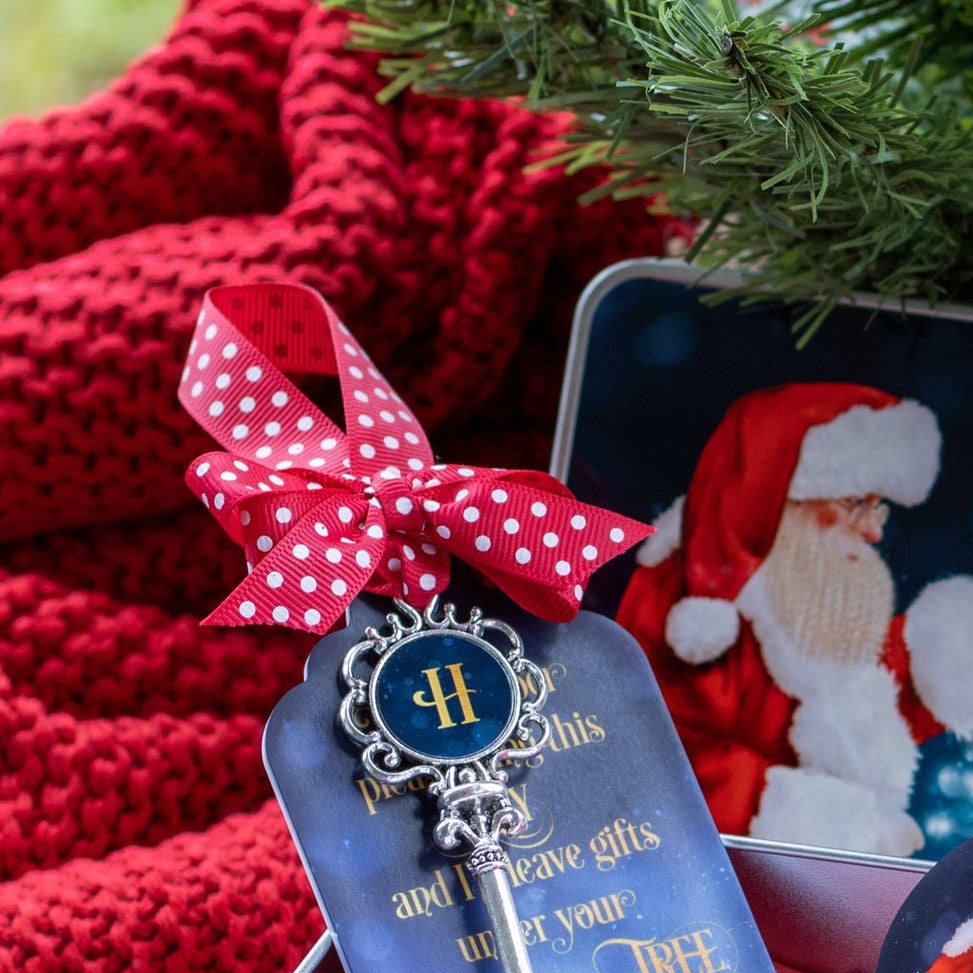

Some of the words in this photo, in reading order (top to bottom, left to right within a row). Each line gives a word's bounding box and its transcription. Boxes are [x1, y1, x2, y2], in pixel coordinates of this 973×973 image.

[412, 662, 481, 730] H
[548, 710, 606, 753] this
[391, 869, 454, 920] and
[502, 842, 586, 888] leave
[589, 818, 661, 872] gifts
[456, 914, 548, 962] uner
[551, 889, 637, 955] your
